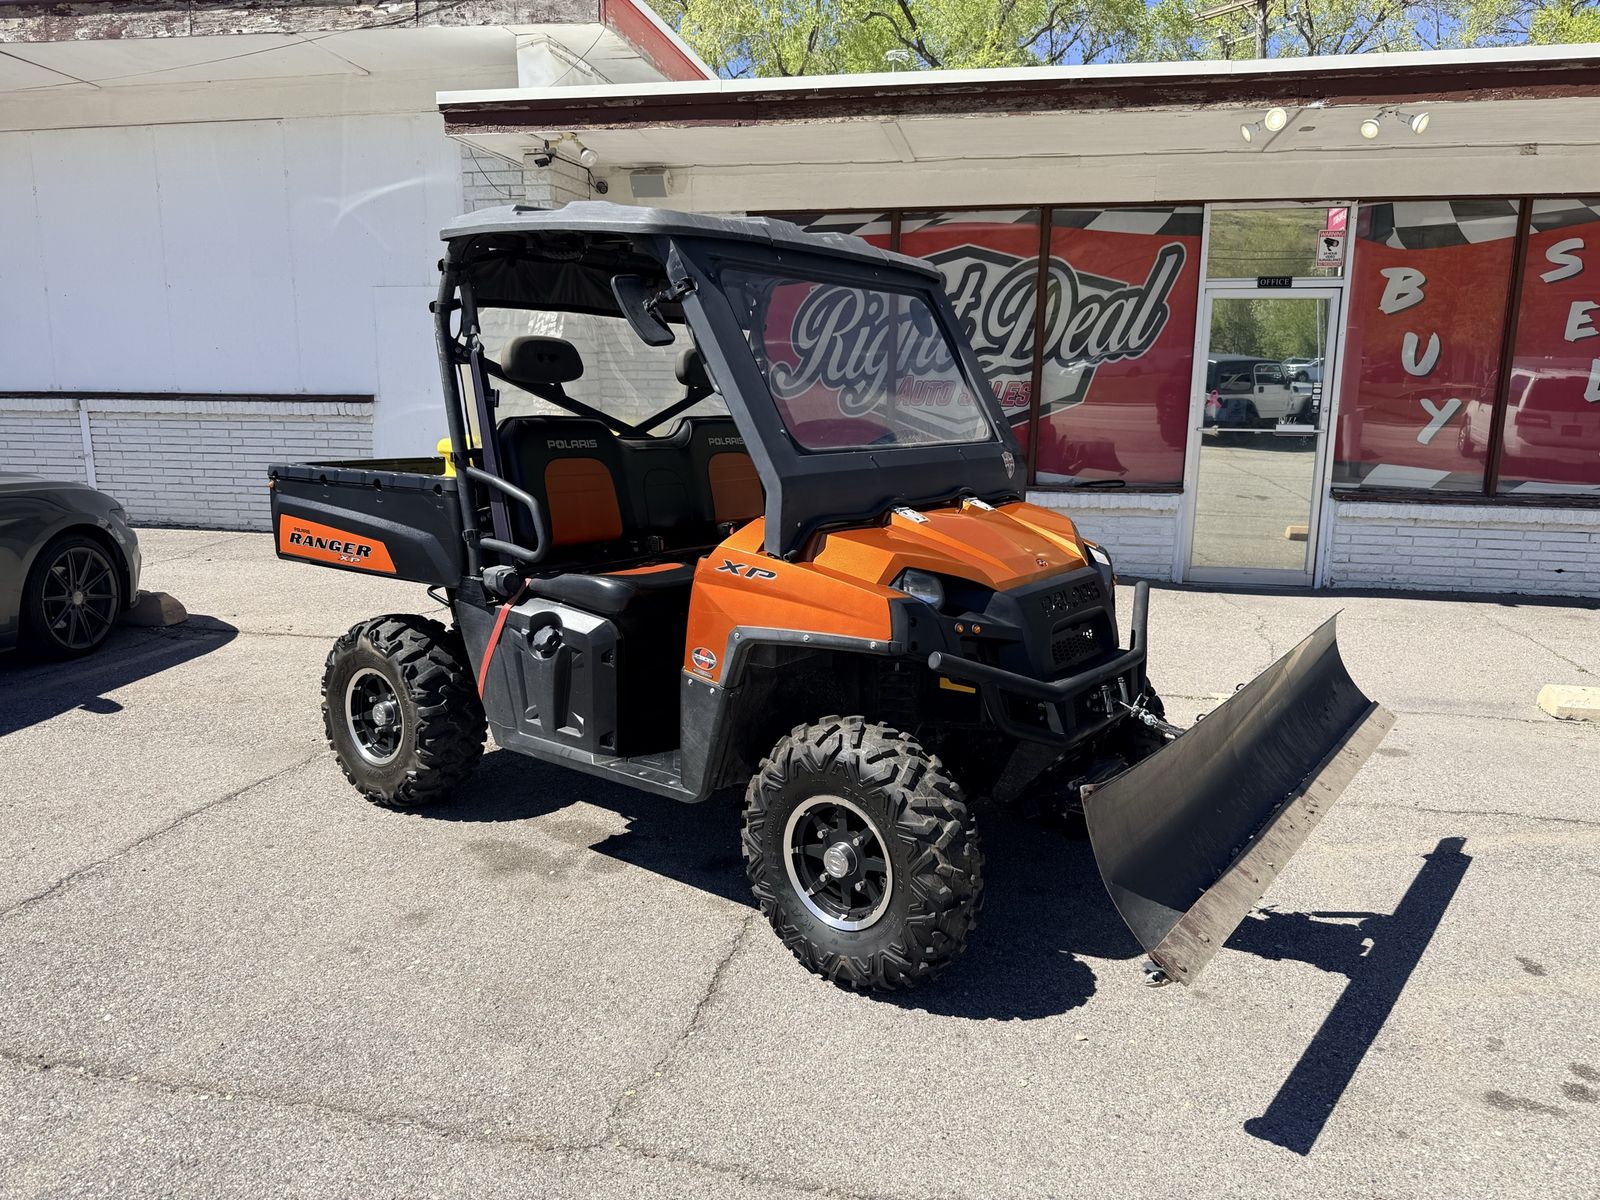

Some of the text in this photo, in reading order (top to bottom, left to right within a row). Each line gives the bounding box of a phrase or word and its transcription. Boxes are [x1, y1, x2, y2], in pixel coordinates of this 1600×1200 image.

[1260, 278, 1290, 286] OFFICE
[980, 243, 1186, 377] Deal
[896, 375, 956, 407] AUTO
[547, 439, 598, 449] POLARIS
[707, 437, 745, 446] POLARIS
[290, 532, 372, 559] RANGER
[339, 555, 360, 563] XP
[715, 559, 777, 581] XP
